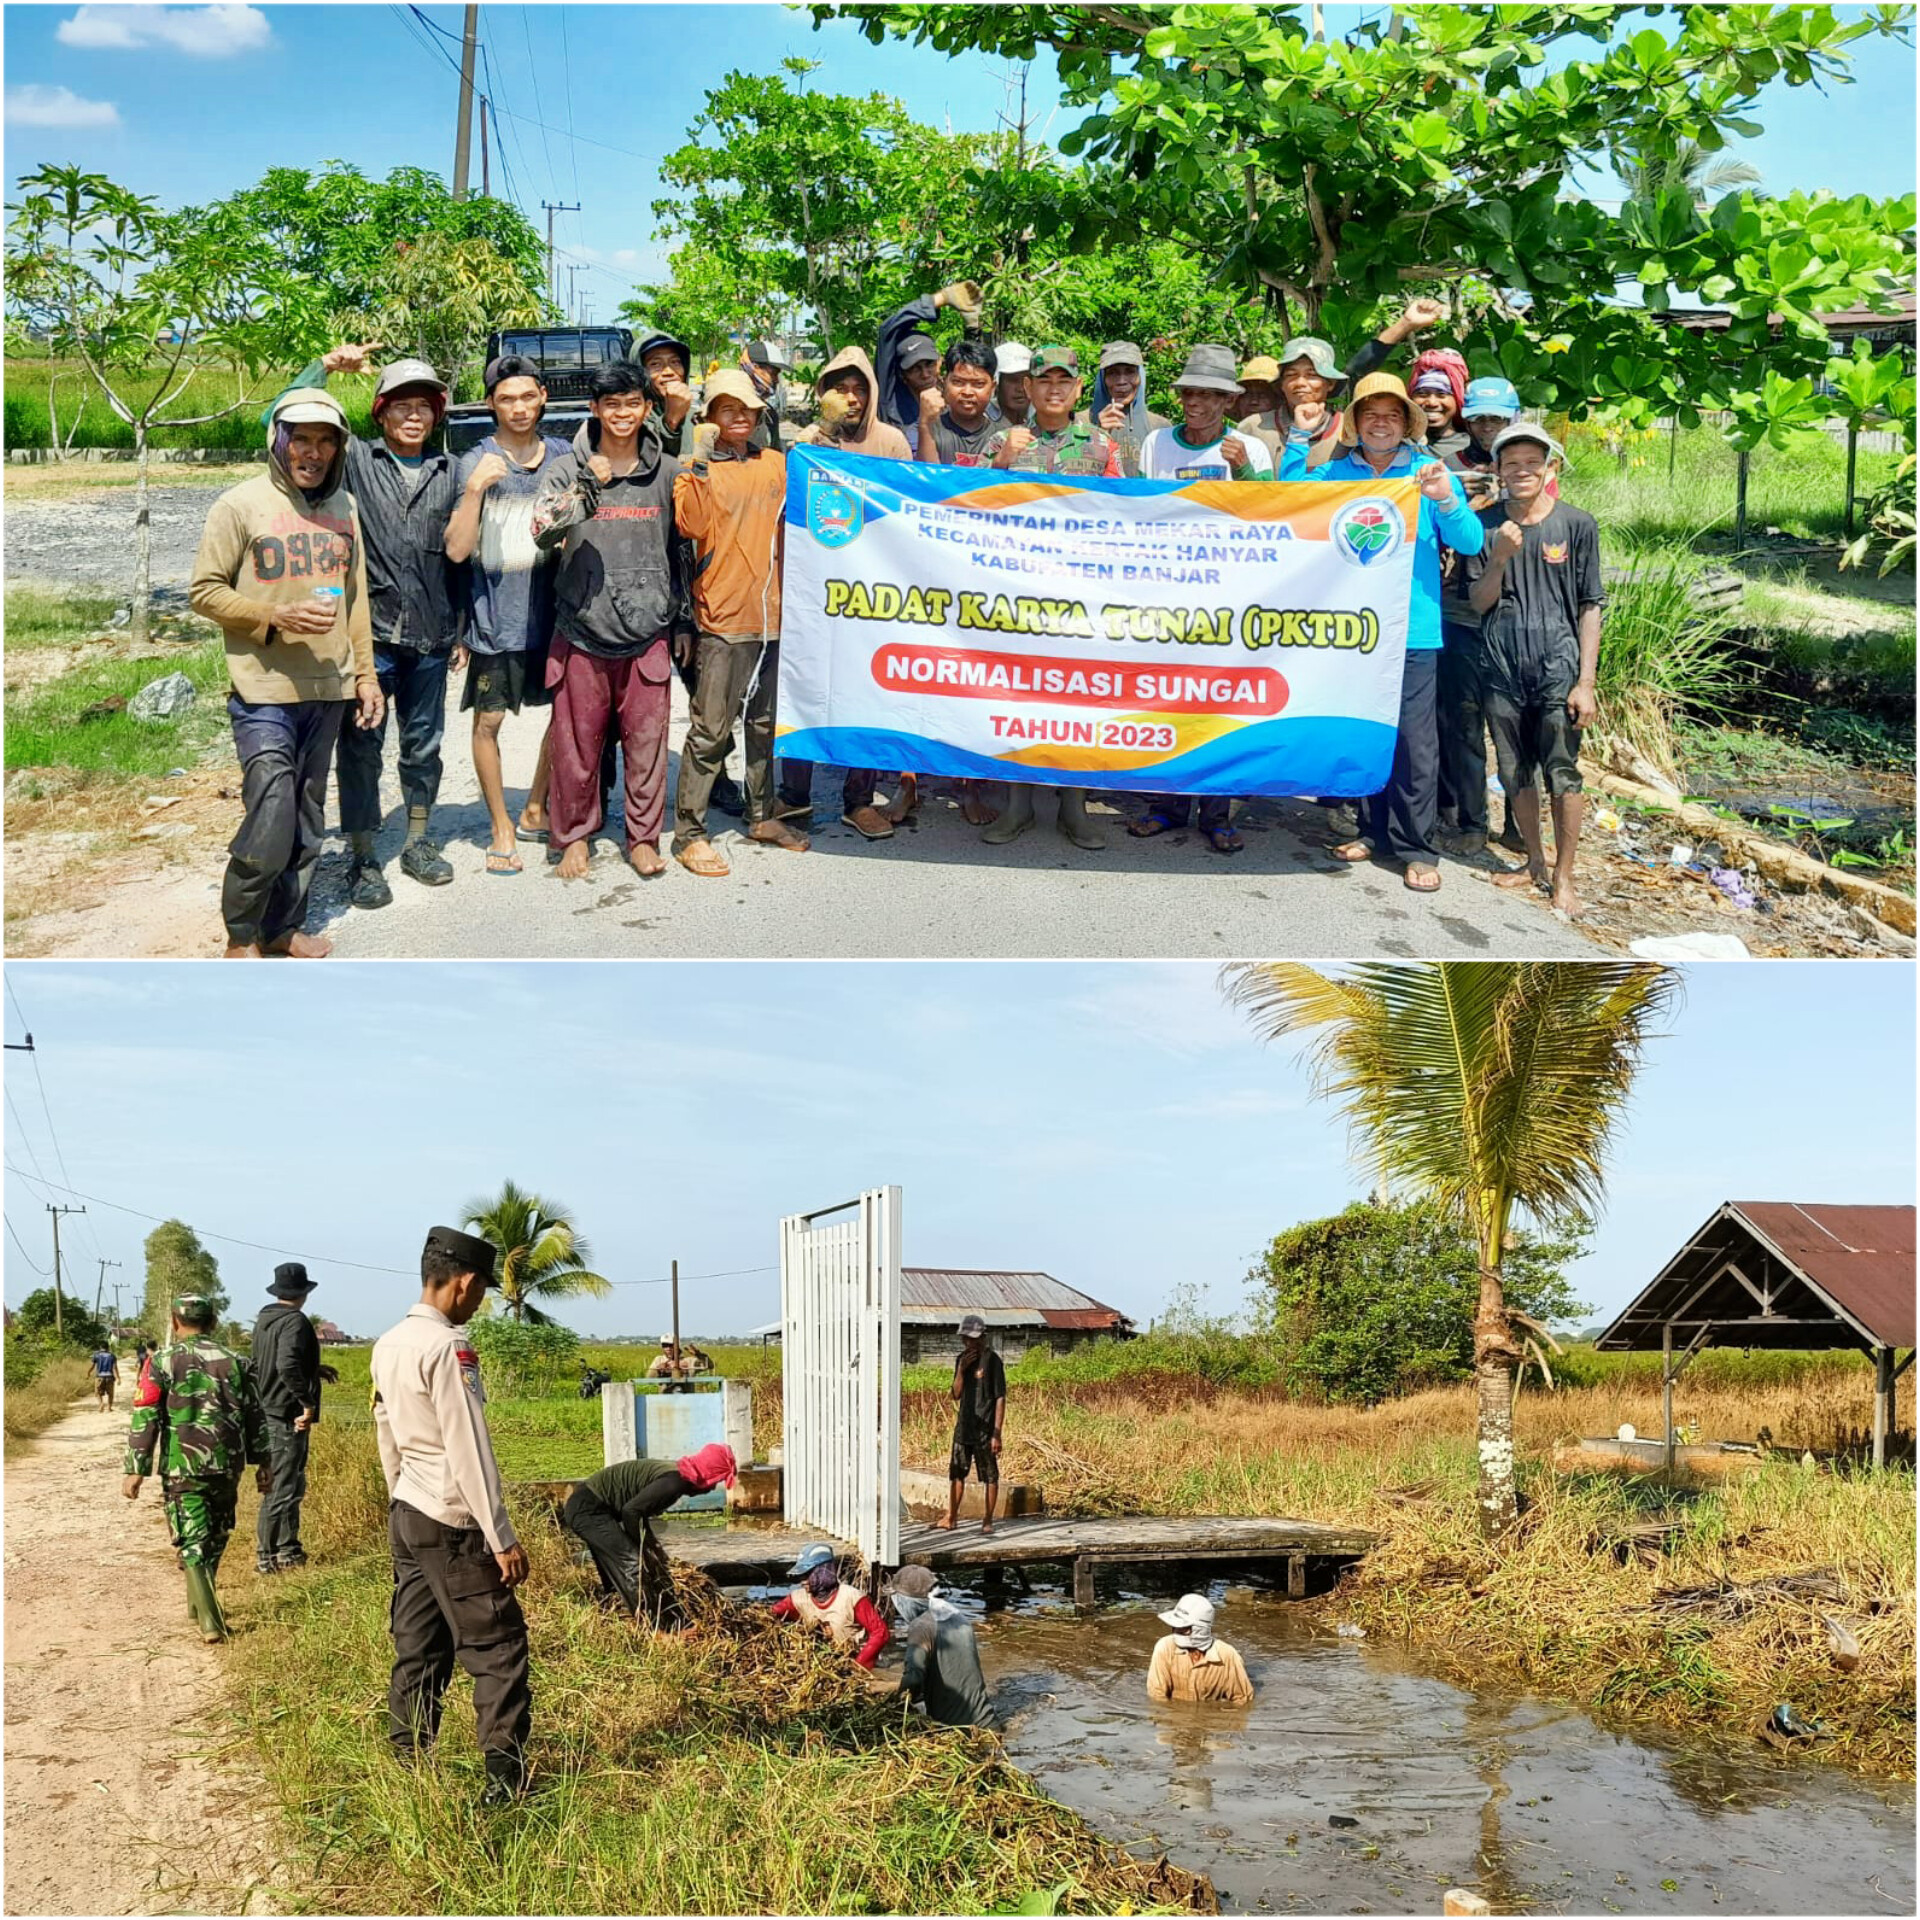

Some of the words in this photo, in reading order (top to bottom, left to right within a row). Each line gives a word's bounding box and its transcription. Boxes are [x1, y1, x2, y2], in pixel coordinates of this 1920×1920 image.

[904, 503, 1056, 532] PEMERINTAH
[1064, 518, 1126, 537] DESA
[1135, 521, 1221, 539] MEKAR
[1229, 524, 1293, 541] RAYA
[971, 551, 1113, 580] KABUPATEN
[1122, 564, 1221, 585] BANJAR
[1072, 541, 1168, 560] KERTAK
[1176, 545, 1278, 563] HANYAR
[825, 579, 952, 625] PADAT
[957, 591, 1095, 638] KARYA
[1101, 603, 1234, 644] TUNAI
[1241, 604, 1379, 655] (PKTD)
[886, 655, 1122, 698] NORMALISASI
[1135, 674, 1267, 703] SUNGAI
[990, 715, 1093, 743] TAHUN
[1103, 724, 1173, 748] 2023
